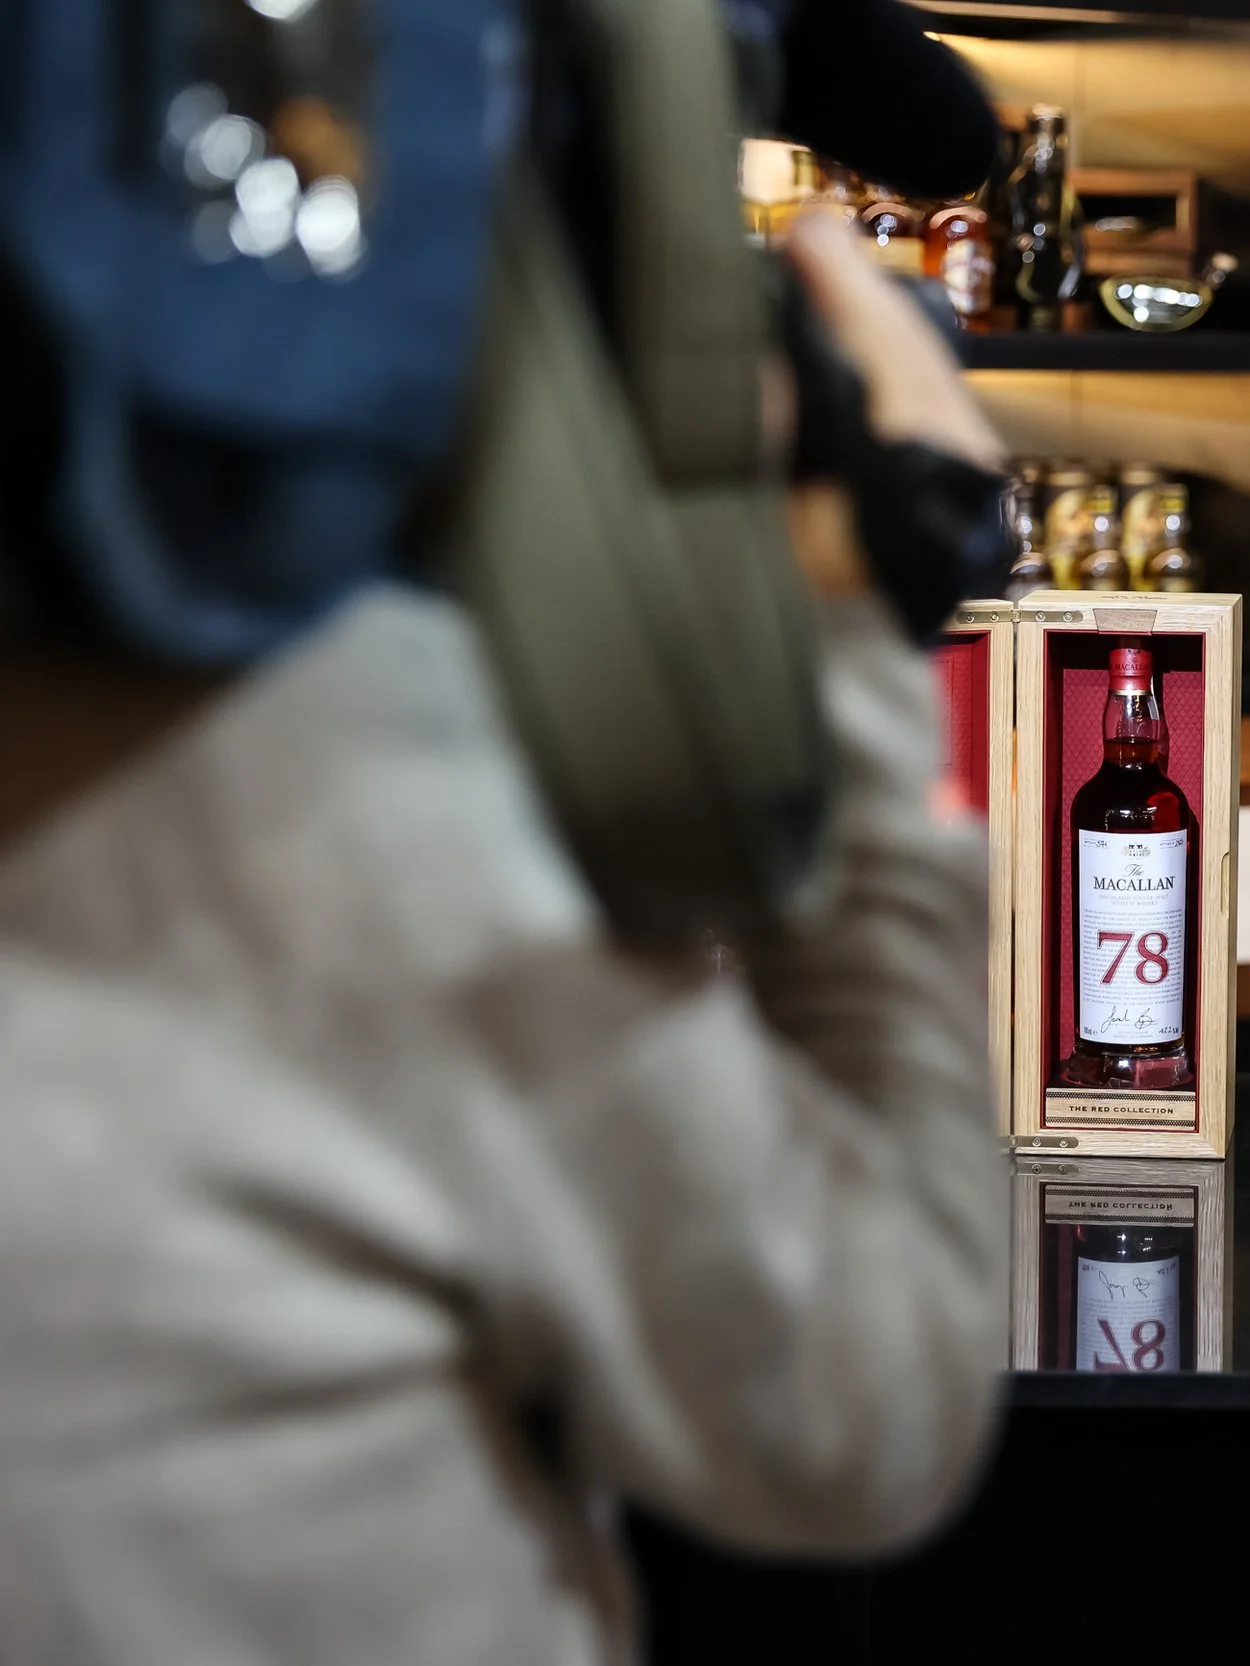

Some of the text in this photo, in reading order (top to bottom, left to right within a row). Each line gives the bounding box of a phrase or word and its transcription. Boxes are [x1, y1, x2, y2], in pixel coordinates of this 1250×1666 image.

[1123, 863, 1144, 877] The
[1093, 876, 1175, 891] MACALLAN
[1097, 929, 1169, 986] 78
[1113, 1106, 1174, 1114] COLLECTION
